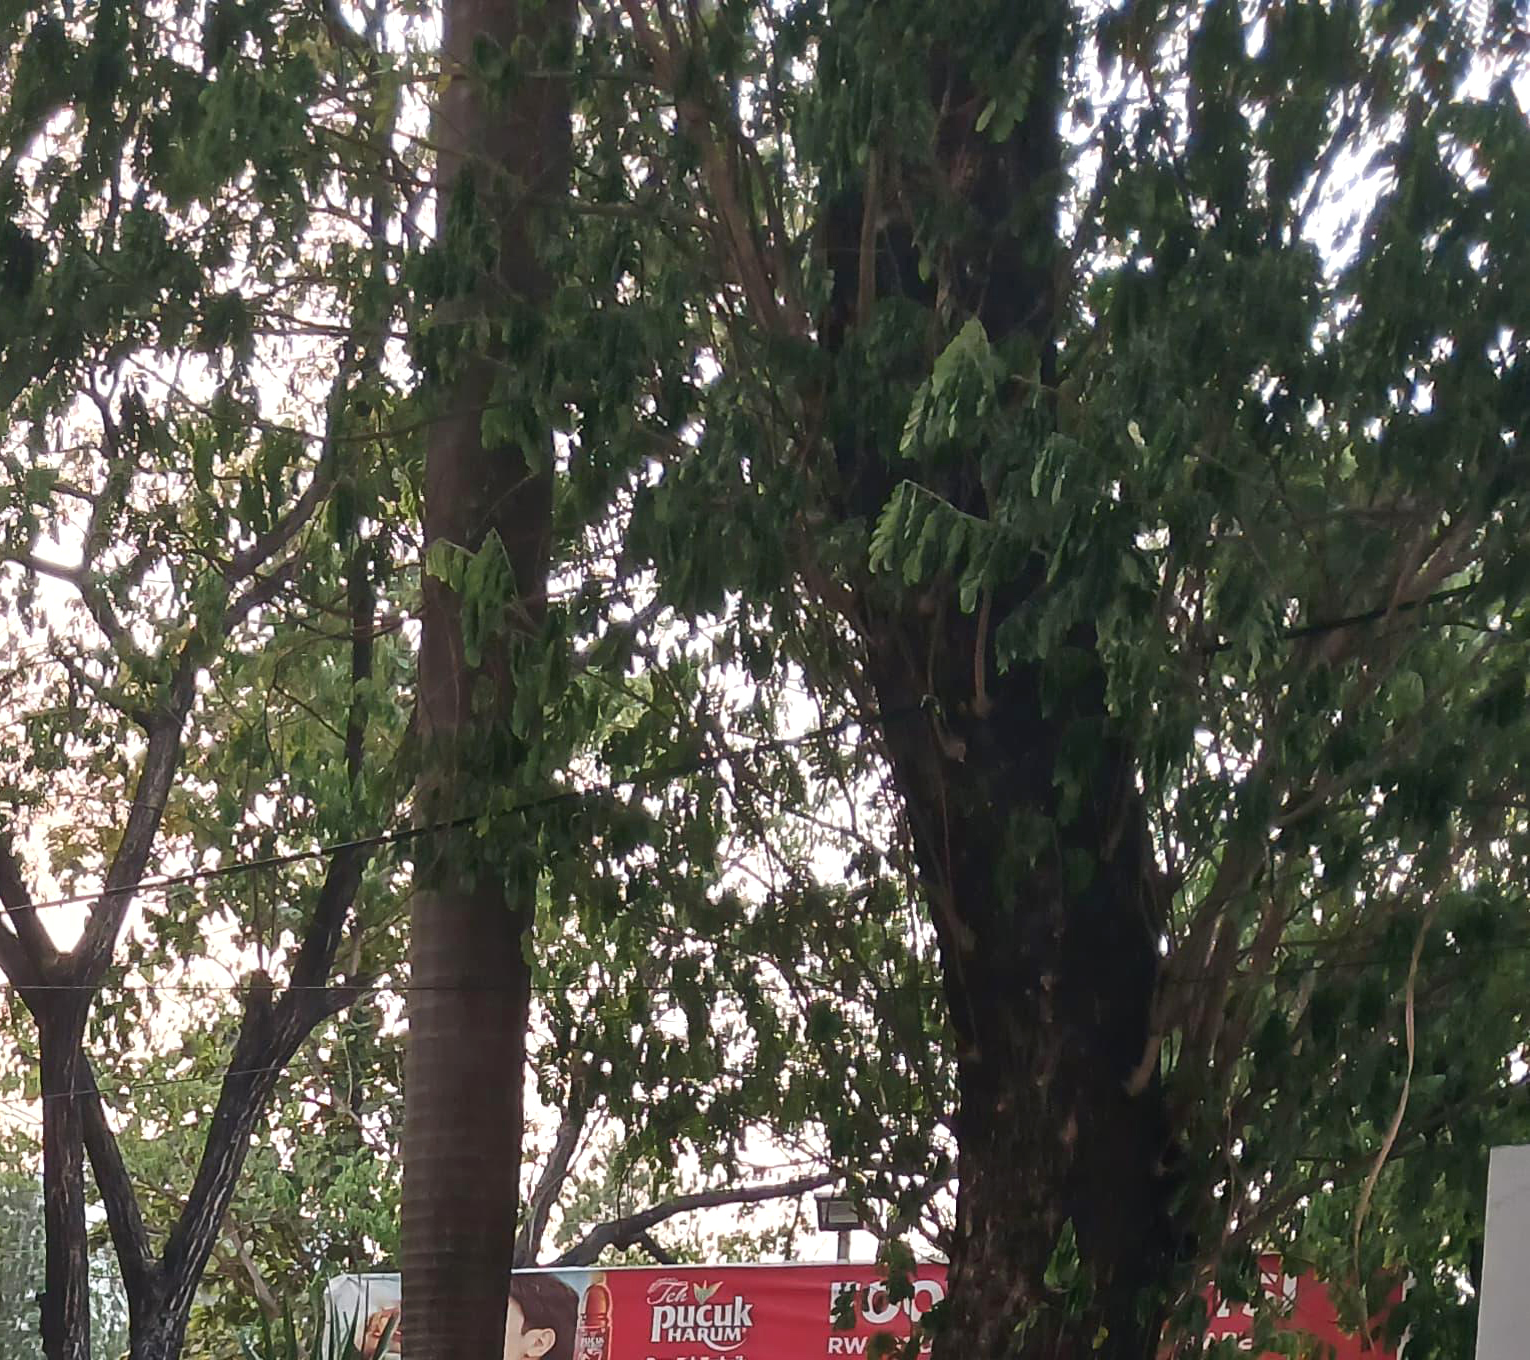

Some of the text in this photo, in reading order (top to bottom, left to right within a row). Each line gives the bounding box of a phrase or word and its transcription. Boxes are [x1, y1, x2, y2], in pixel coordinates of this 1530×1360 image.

[647, 1278, 689, 1305] Teh
[651, 1296, 753, 1342] pucuk
[669, 1327, 747, 1347] HARUM
[828, 1337, 868, 1354] RW
